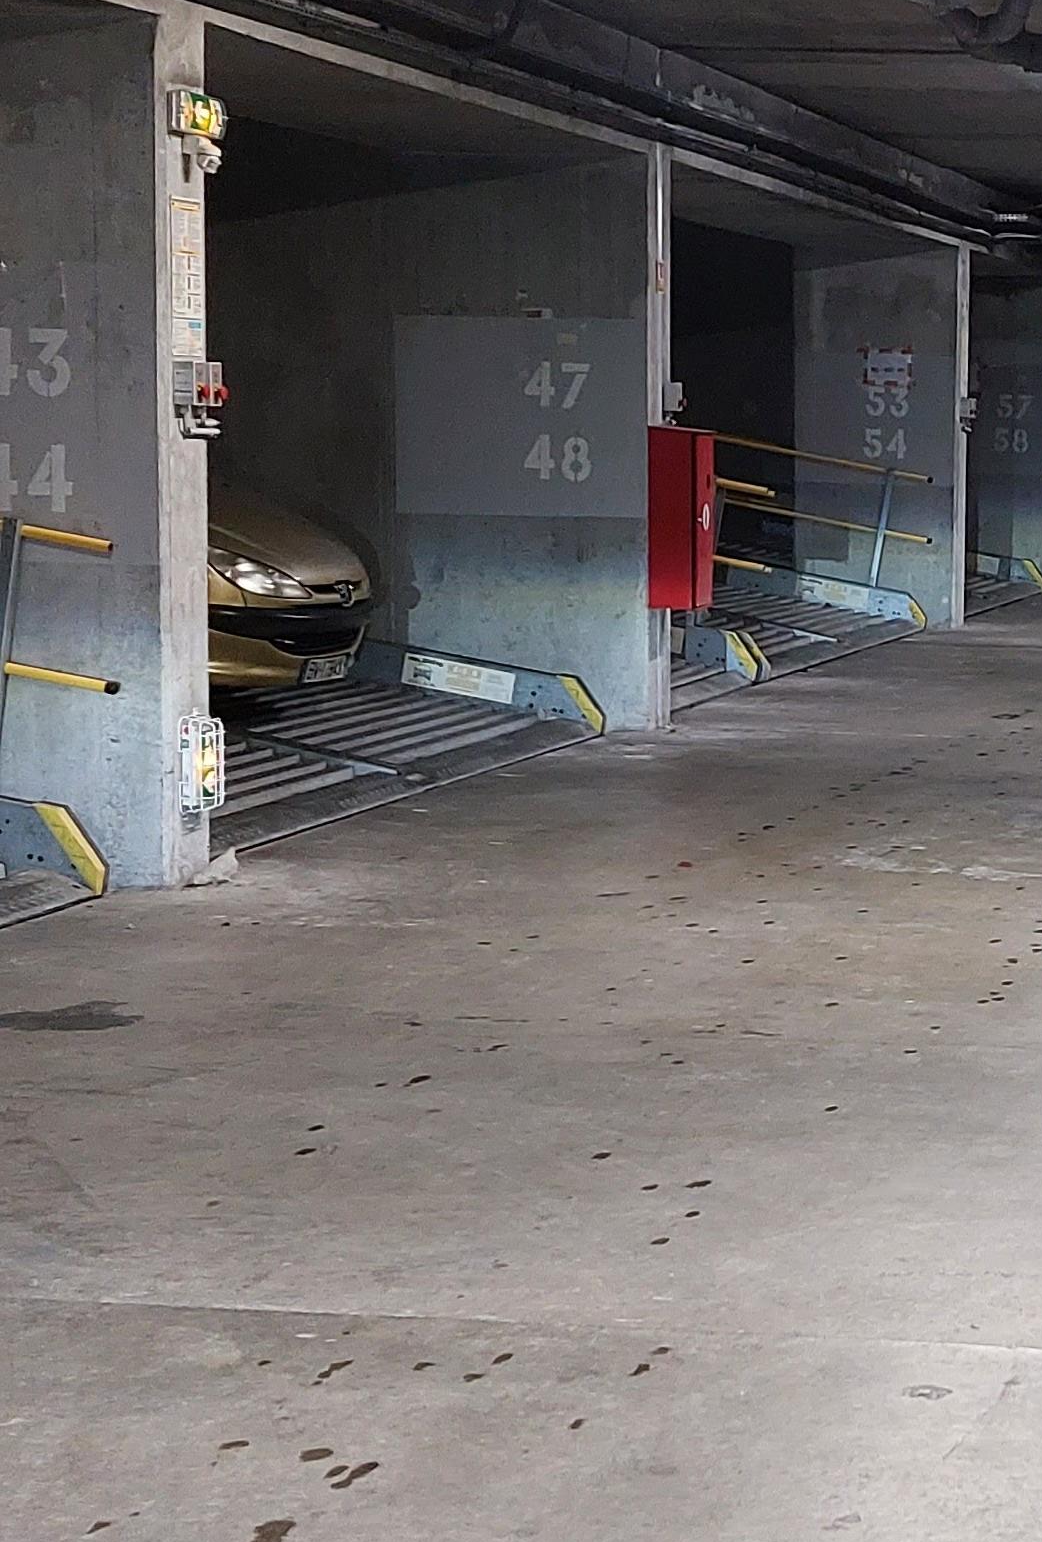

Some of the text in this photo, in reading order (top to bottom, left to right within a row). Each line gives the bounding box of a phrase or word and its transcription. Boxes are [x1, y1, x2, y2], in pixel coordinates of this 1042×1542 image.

[524, 361, 591, 409] 47
[865, 386, 909, 417] 53
[997, 394, 1034, 420] 57
[863, 428, 907, 459] 54
[993, 427, 1030, 453] 58
[524, 434, 592, 483] 48
